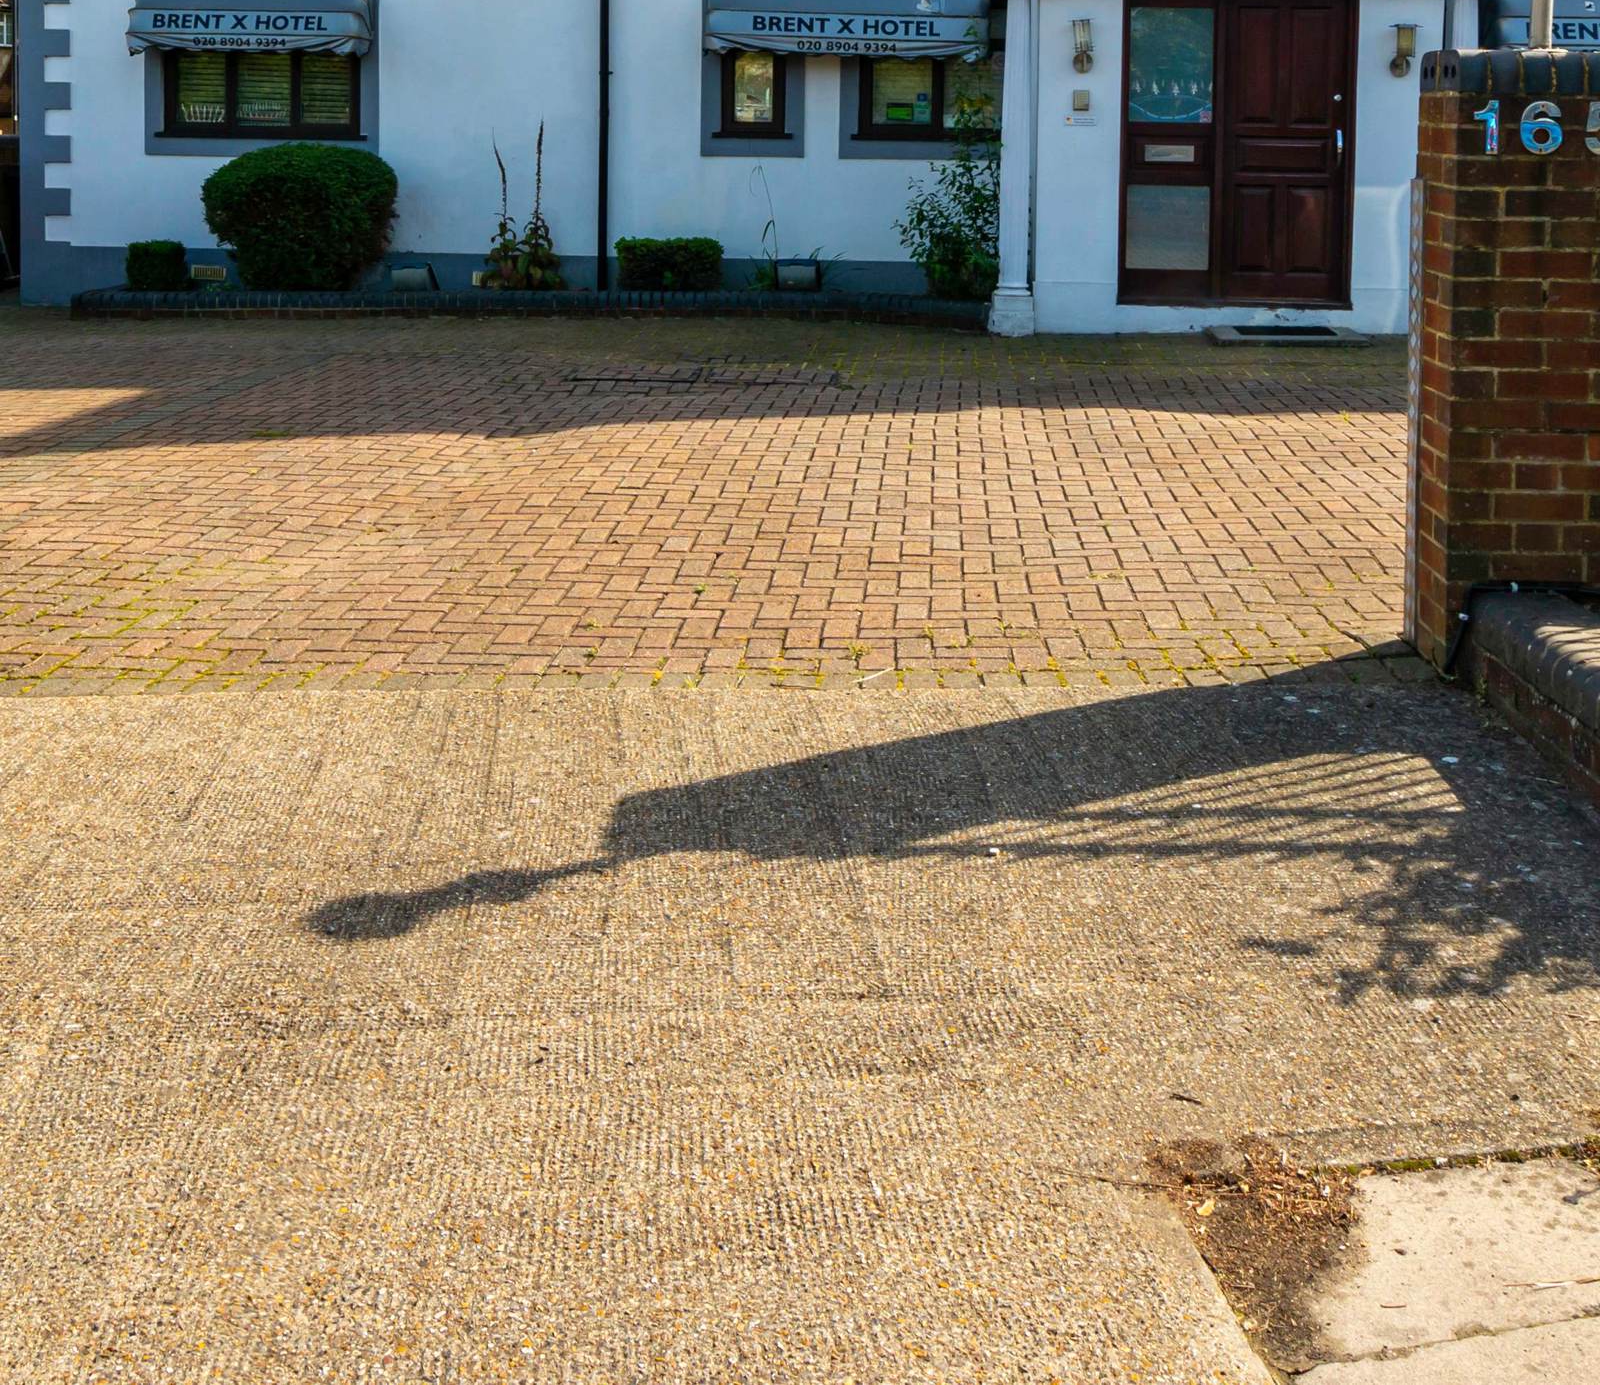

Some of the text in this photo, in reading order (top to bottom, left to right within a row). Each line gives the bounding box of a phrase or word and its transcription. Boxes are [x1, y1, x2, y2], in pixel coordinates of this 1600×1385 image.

[152, 13, 327, 31] BRENT X HOTEL
[752, 15, 941, 37] BRENT X HOTEL
[193, 37, 286, 48] 020 8904 9394
[797, 40, 896, 53] 020 8904 9394
